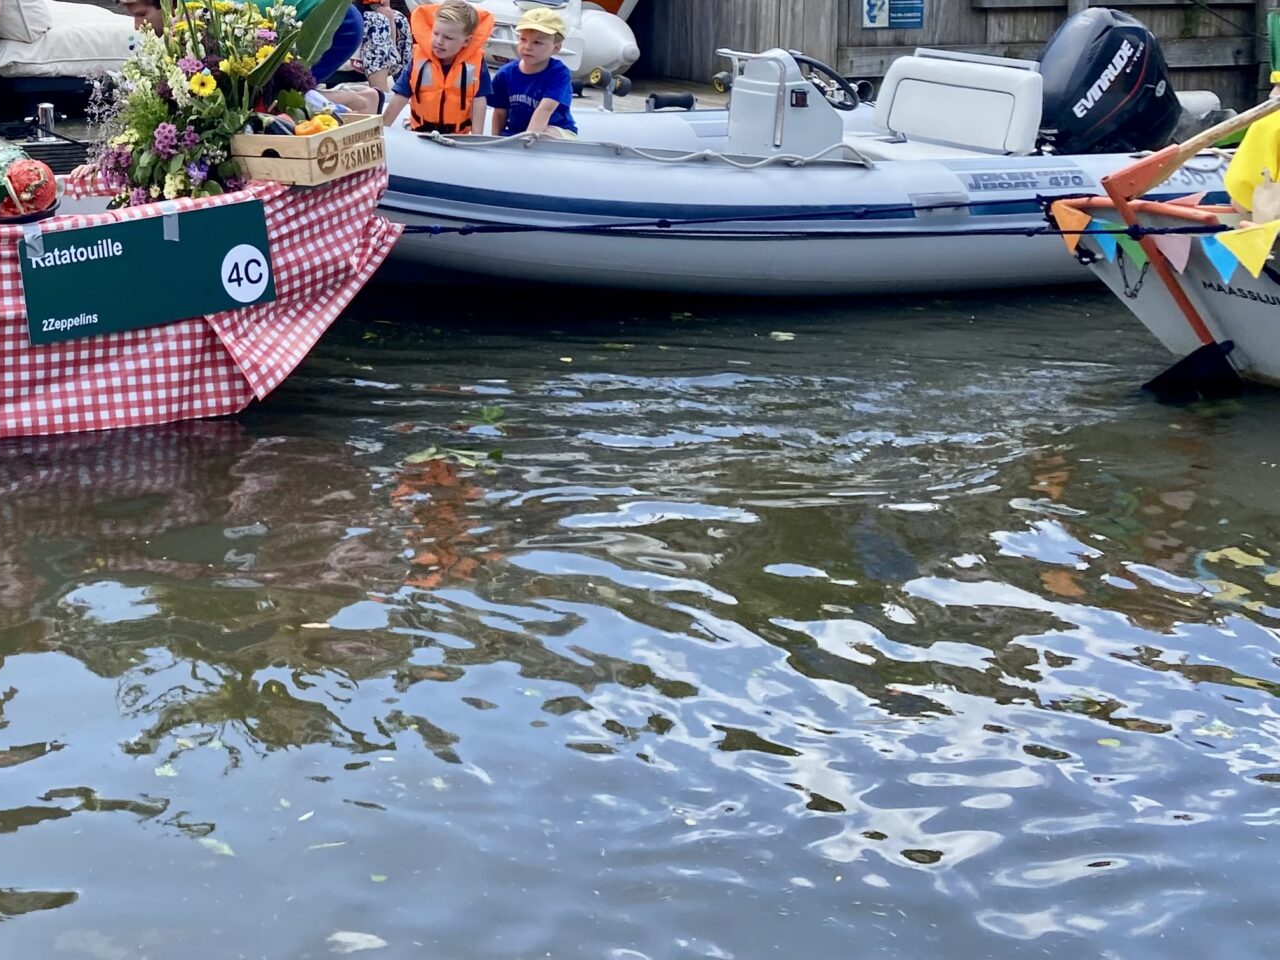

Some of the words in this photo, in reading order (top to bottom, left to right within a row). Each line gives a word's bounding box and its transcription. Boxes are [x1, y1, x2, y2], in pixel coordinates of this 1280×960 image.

[1072, 39, 1134, 119] EVINRUDE
[345, 142, 383, 169] 2SAMEN
[1048, 175, 1083, 187] 470
[227, 258, 263, 288] 4C
[42, 312, 98, 331] 2Zeppelins
